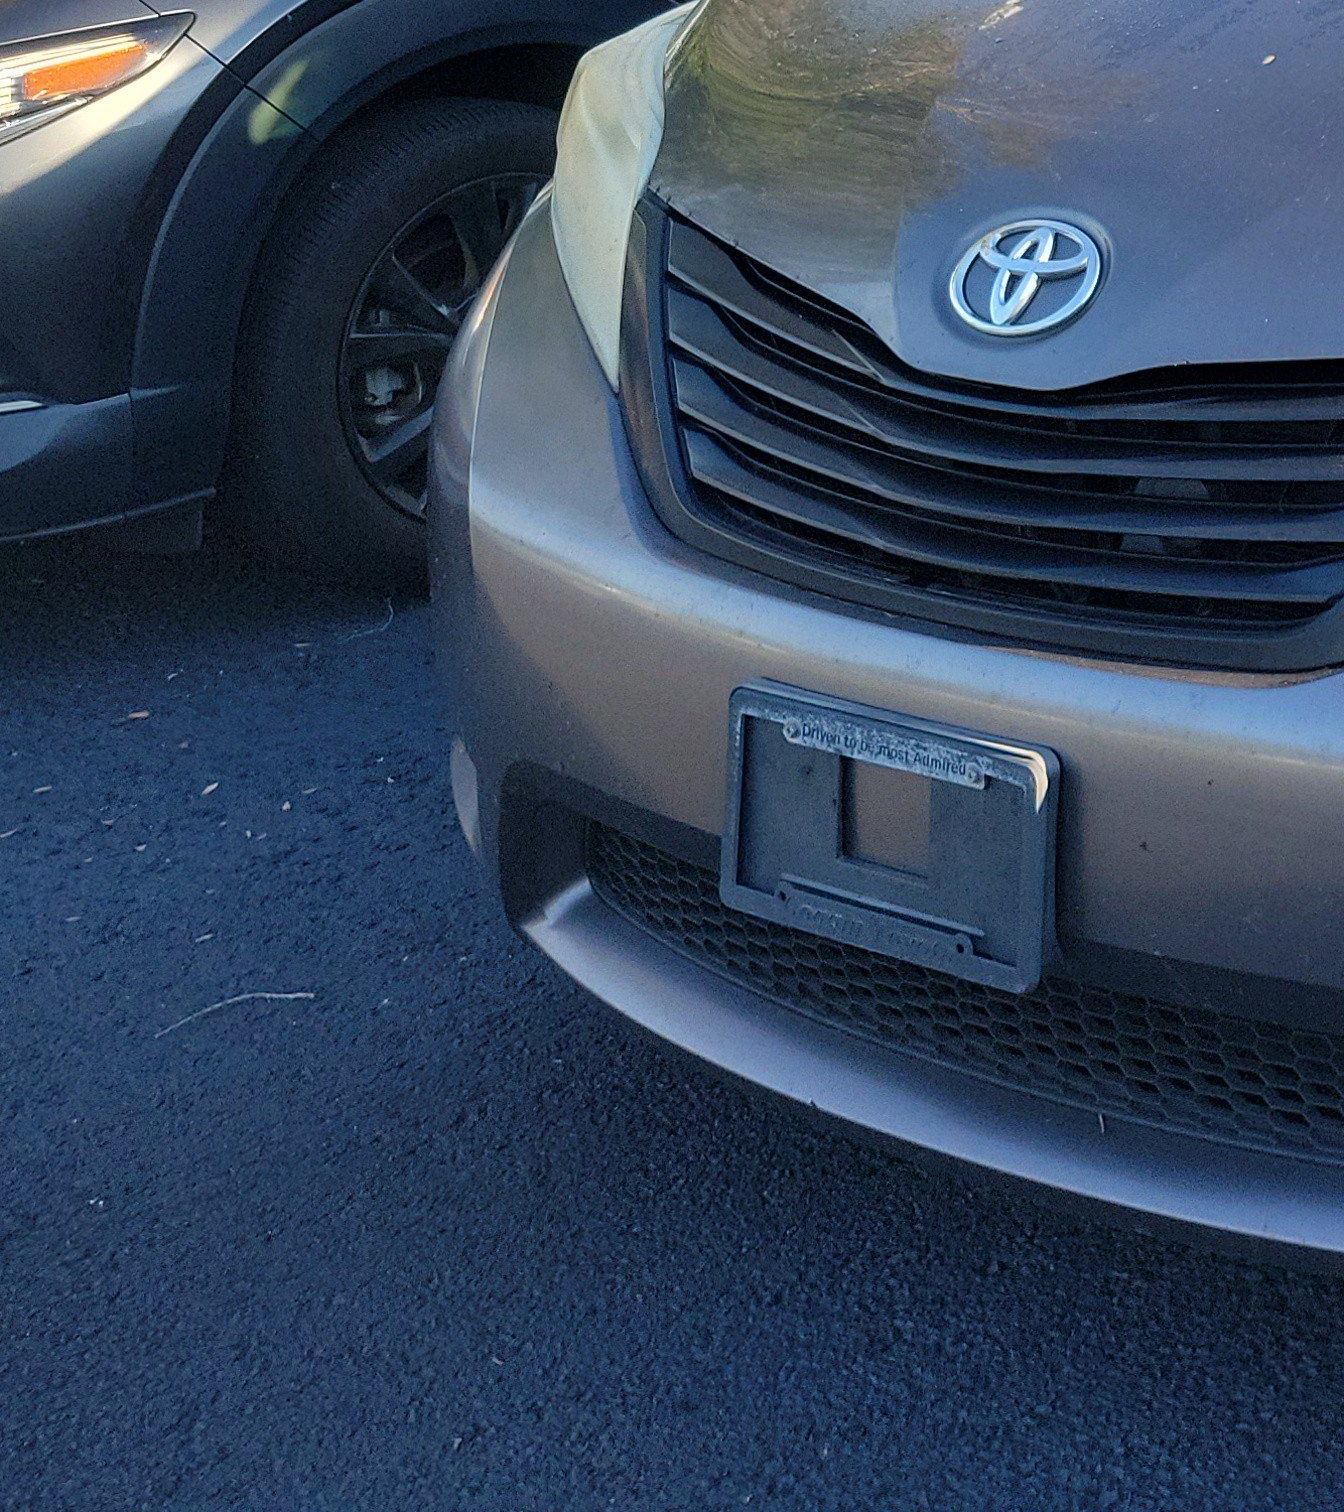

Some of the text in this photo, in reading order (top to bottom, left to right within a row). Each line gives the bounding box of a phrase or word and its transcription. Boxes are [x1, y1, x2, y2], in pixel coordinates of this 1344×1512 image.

[844, 735, 856, 749] to
[878, 744, 909, 762] most
[913, 752, 966, 776] Admired
